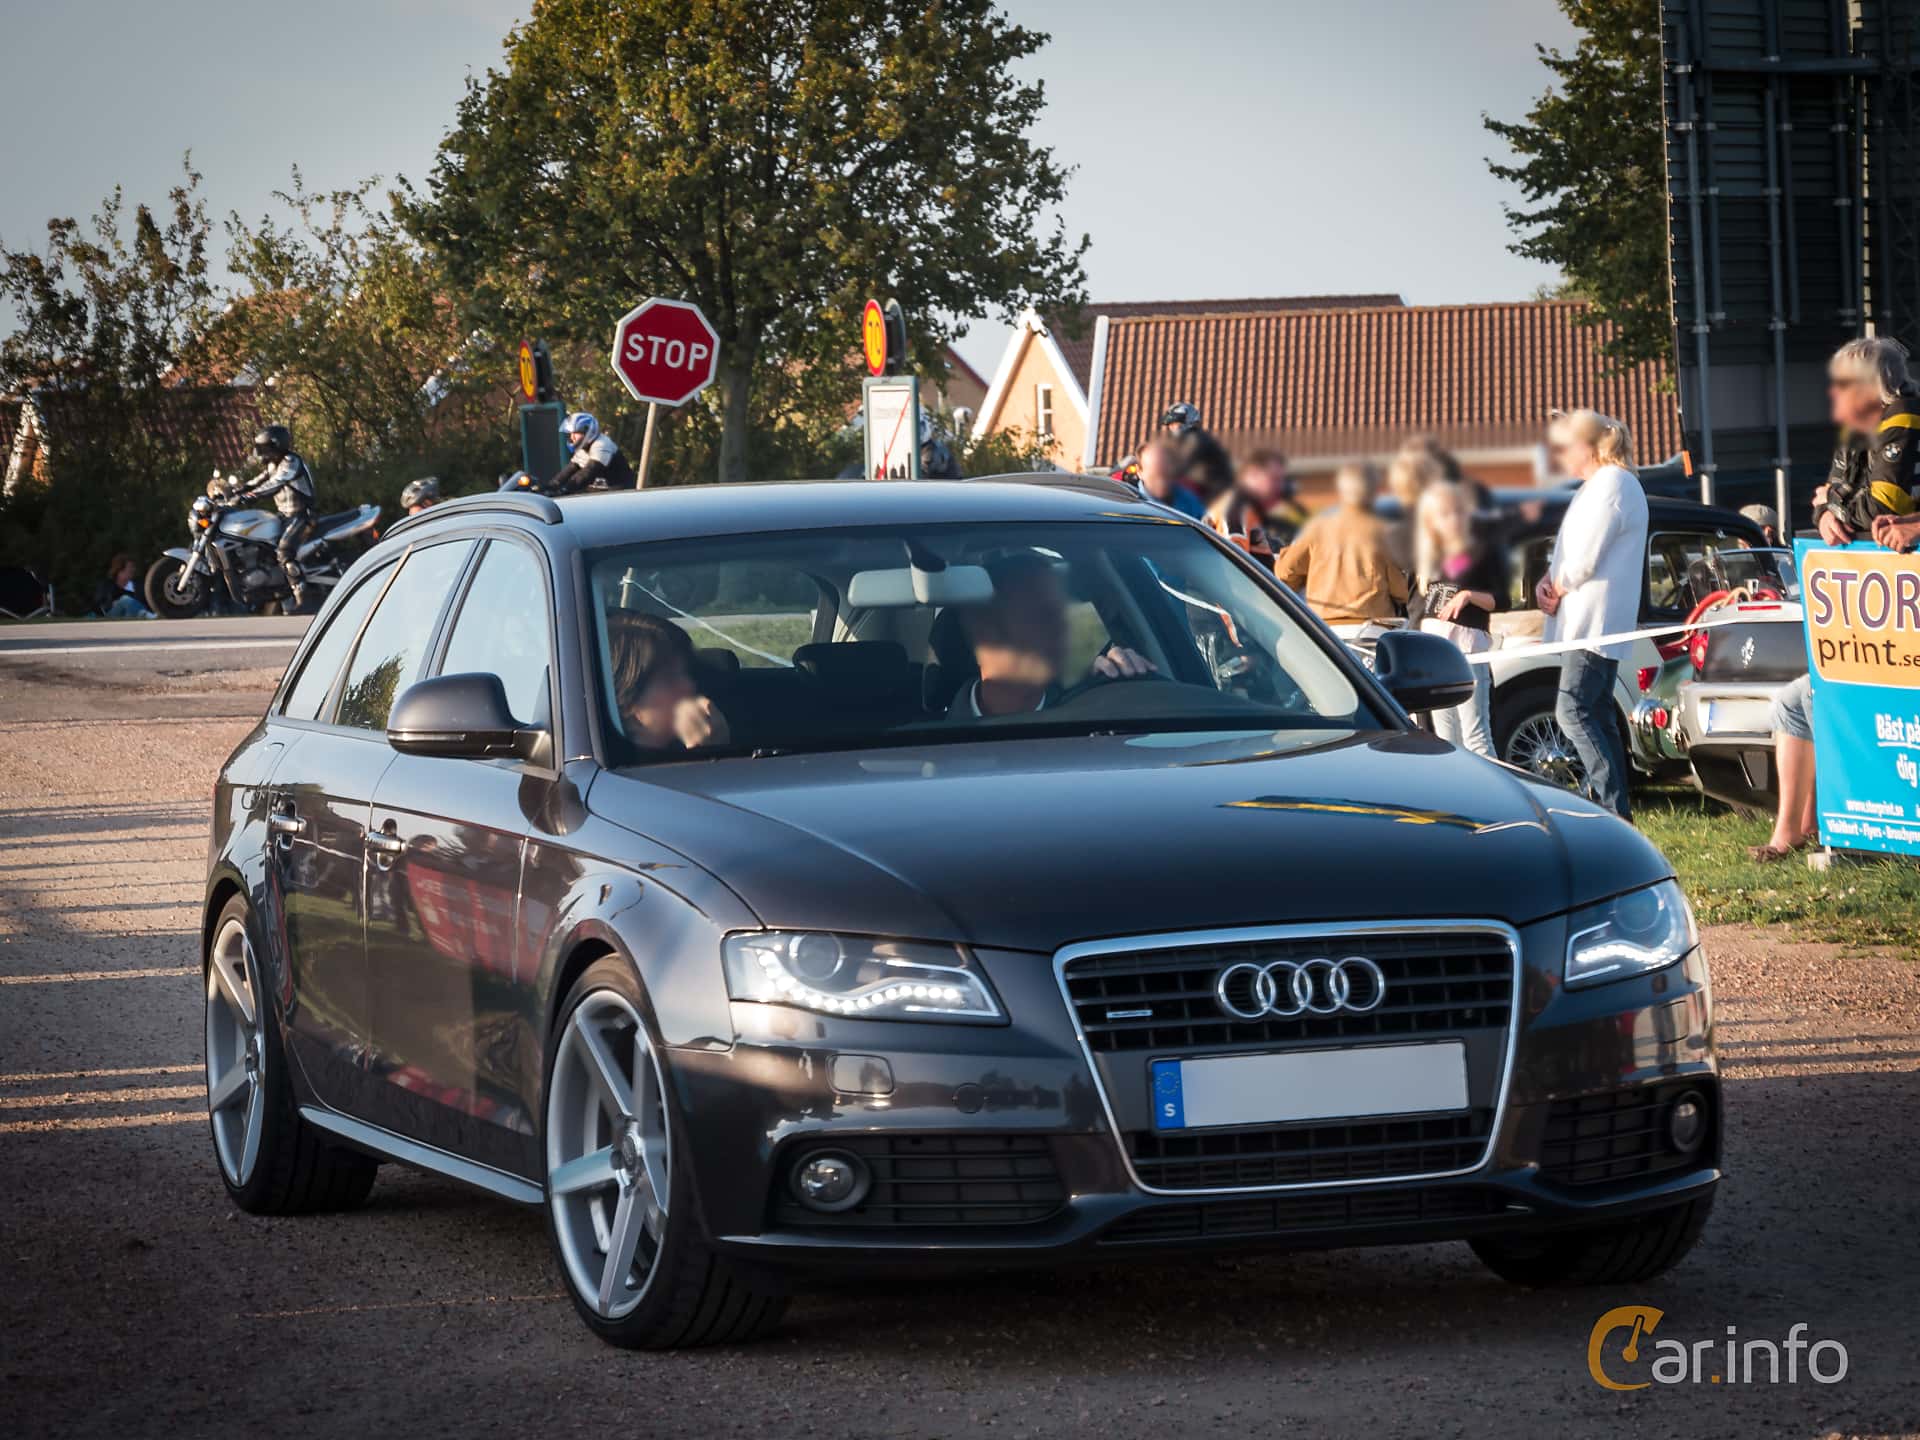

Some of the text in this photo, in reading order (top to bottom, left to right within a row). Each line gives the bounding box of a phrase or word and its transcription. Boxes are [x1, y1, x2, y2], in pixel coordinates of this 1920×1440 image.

[625, 333, 709, 373] STOP
[867, 320, 882, 356] 70
[1809, 569, 1920, 630] STOR
[1817, 634, 1920, 668] print.se
[1875, 713, 1905, 741] Bäst
[1896, 753, 1918, 788] dig
[1163, 1102, 1177, 1118] S
